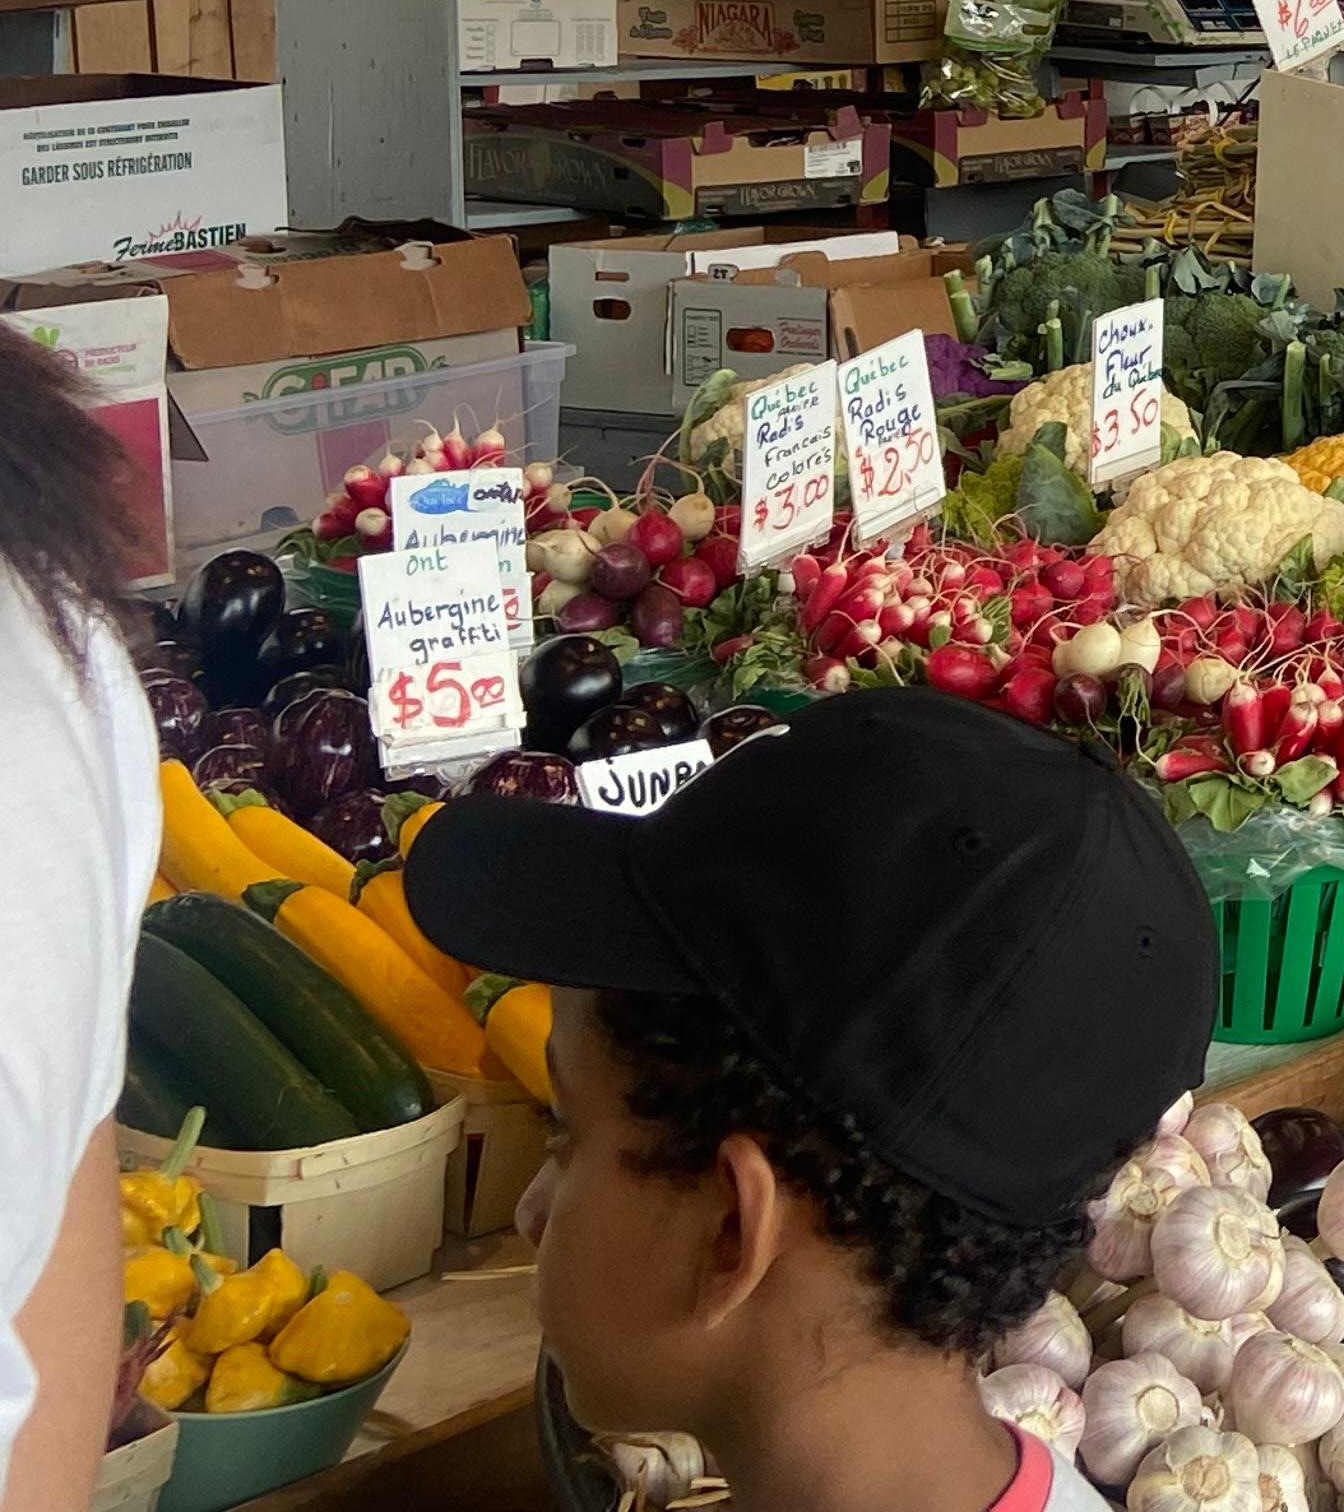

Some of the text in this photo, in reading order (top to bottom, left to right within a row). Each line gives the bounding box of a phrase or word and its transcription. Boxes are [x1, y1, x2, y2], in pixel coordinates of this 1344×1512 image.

[698, 1, 773, 46] NIAGARA
[23, 151, 193, 186] GARDER SOUS RÉFRIGÉRATION
[113, 221, 247, 262] Ferme BASTIEN
[849, 383, 907, 424] Radis
[756, 414, 805, 450] Radis
[860, 404, 922, 445] Rouge
[377, 588, 500, 632] Aubergine
[409, 622, 501, 666] graffiti
